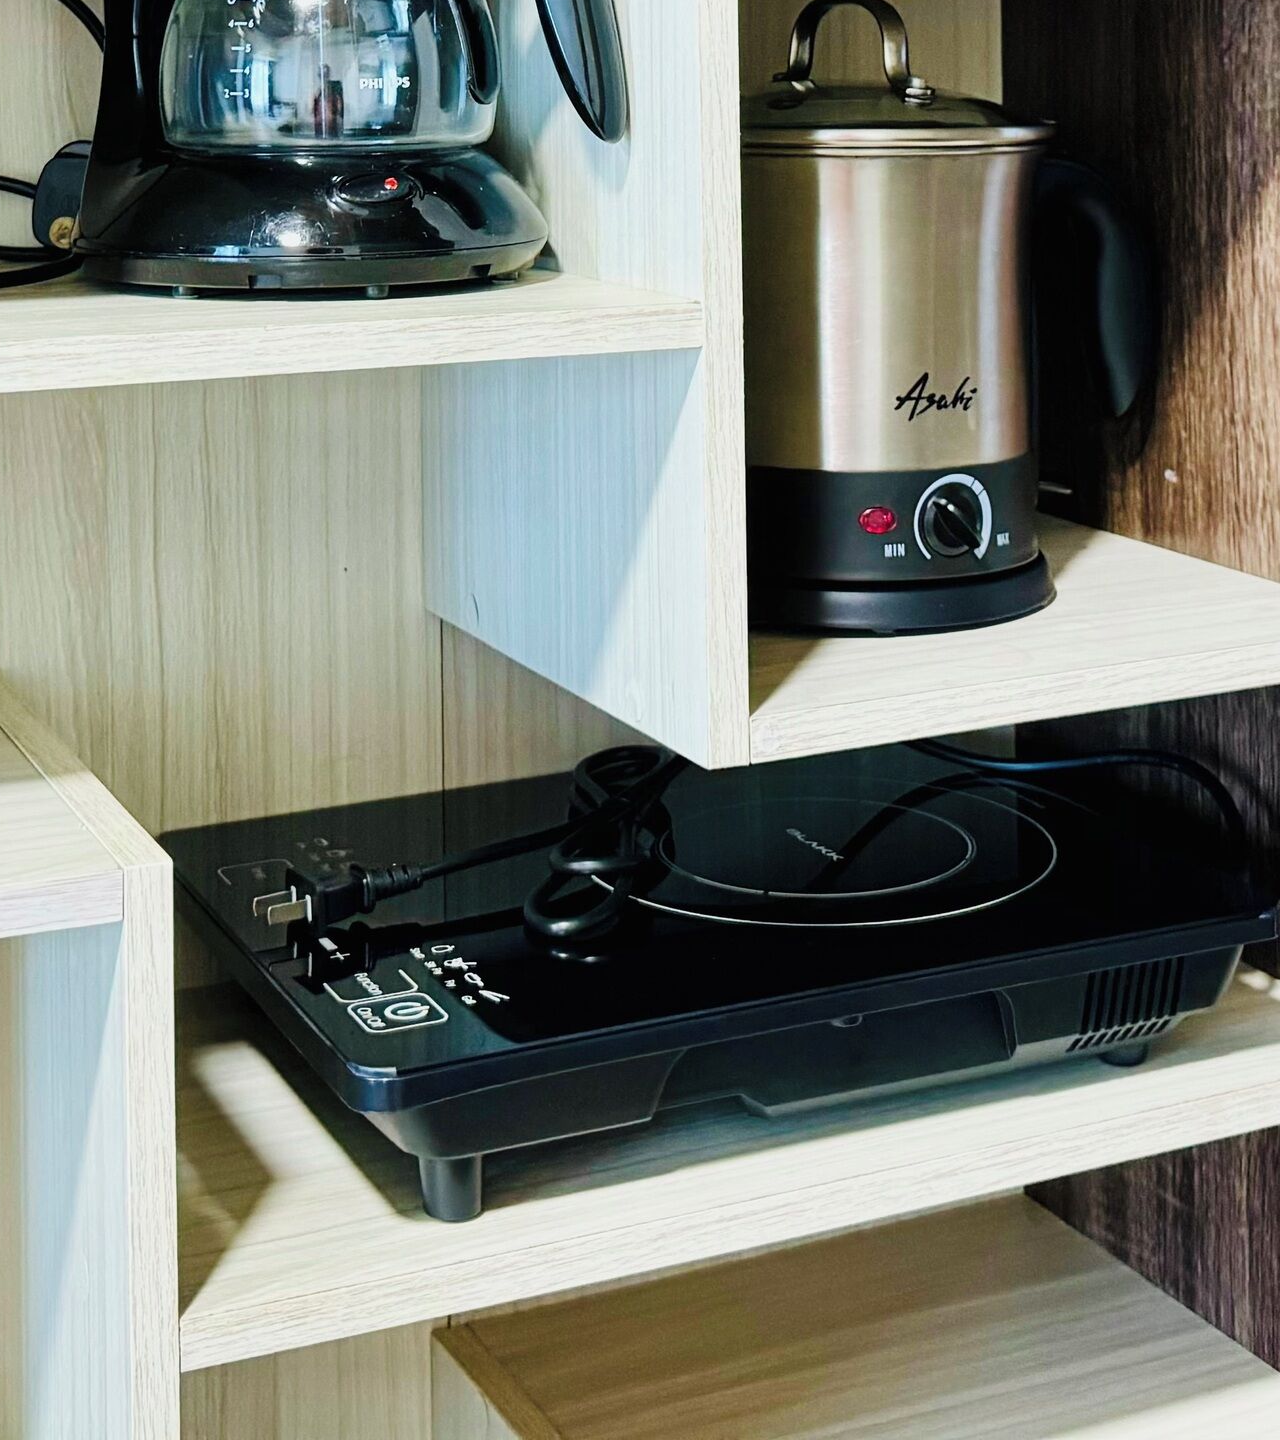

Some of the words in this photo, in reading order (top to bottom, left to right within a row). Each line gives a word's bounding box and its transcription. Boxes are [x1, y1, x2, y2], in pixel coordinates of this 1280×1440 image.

[228, 19, 235, 28] 4
[248, 18, 255, 28] 6
[245, 43, 252, 53] 5
[243, 65, 251, 75] 4
[359, 76, 411, 89] PHIPS
[223, 88, 230, 99] 2
[243, 88, 250, 98] 3
[894, 372, 978, 422] Asahi
[884, 543, 905, 558] MIN
